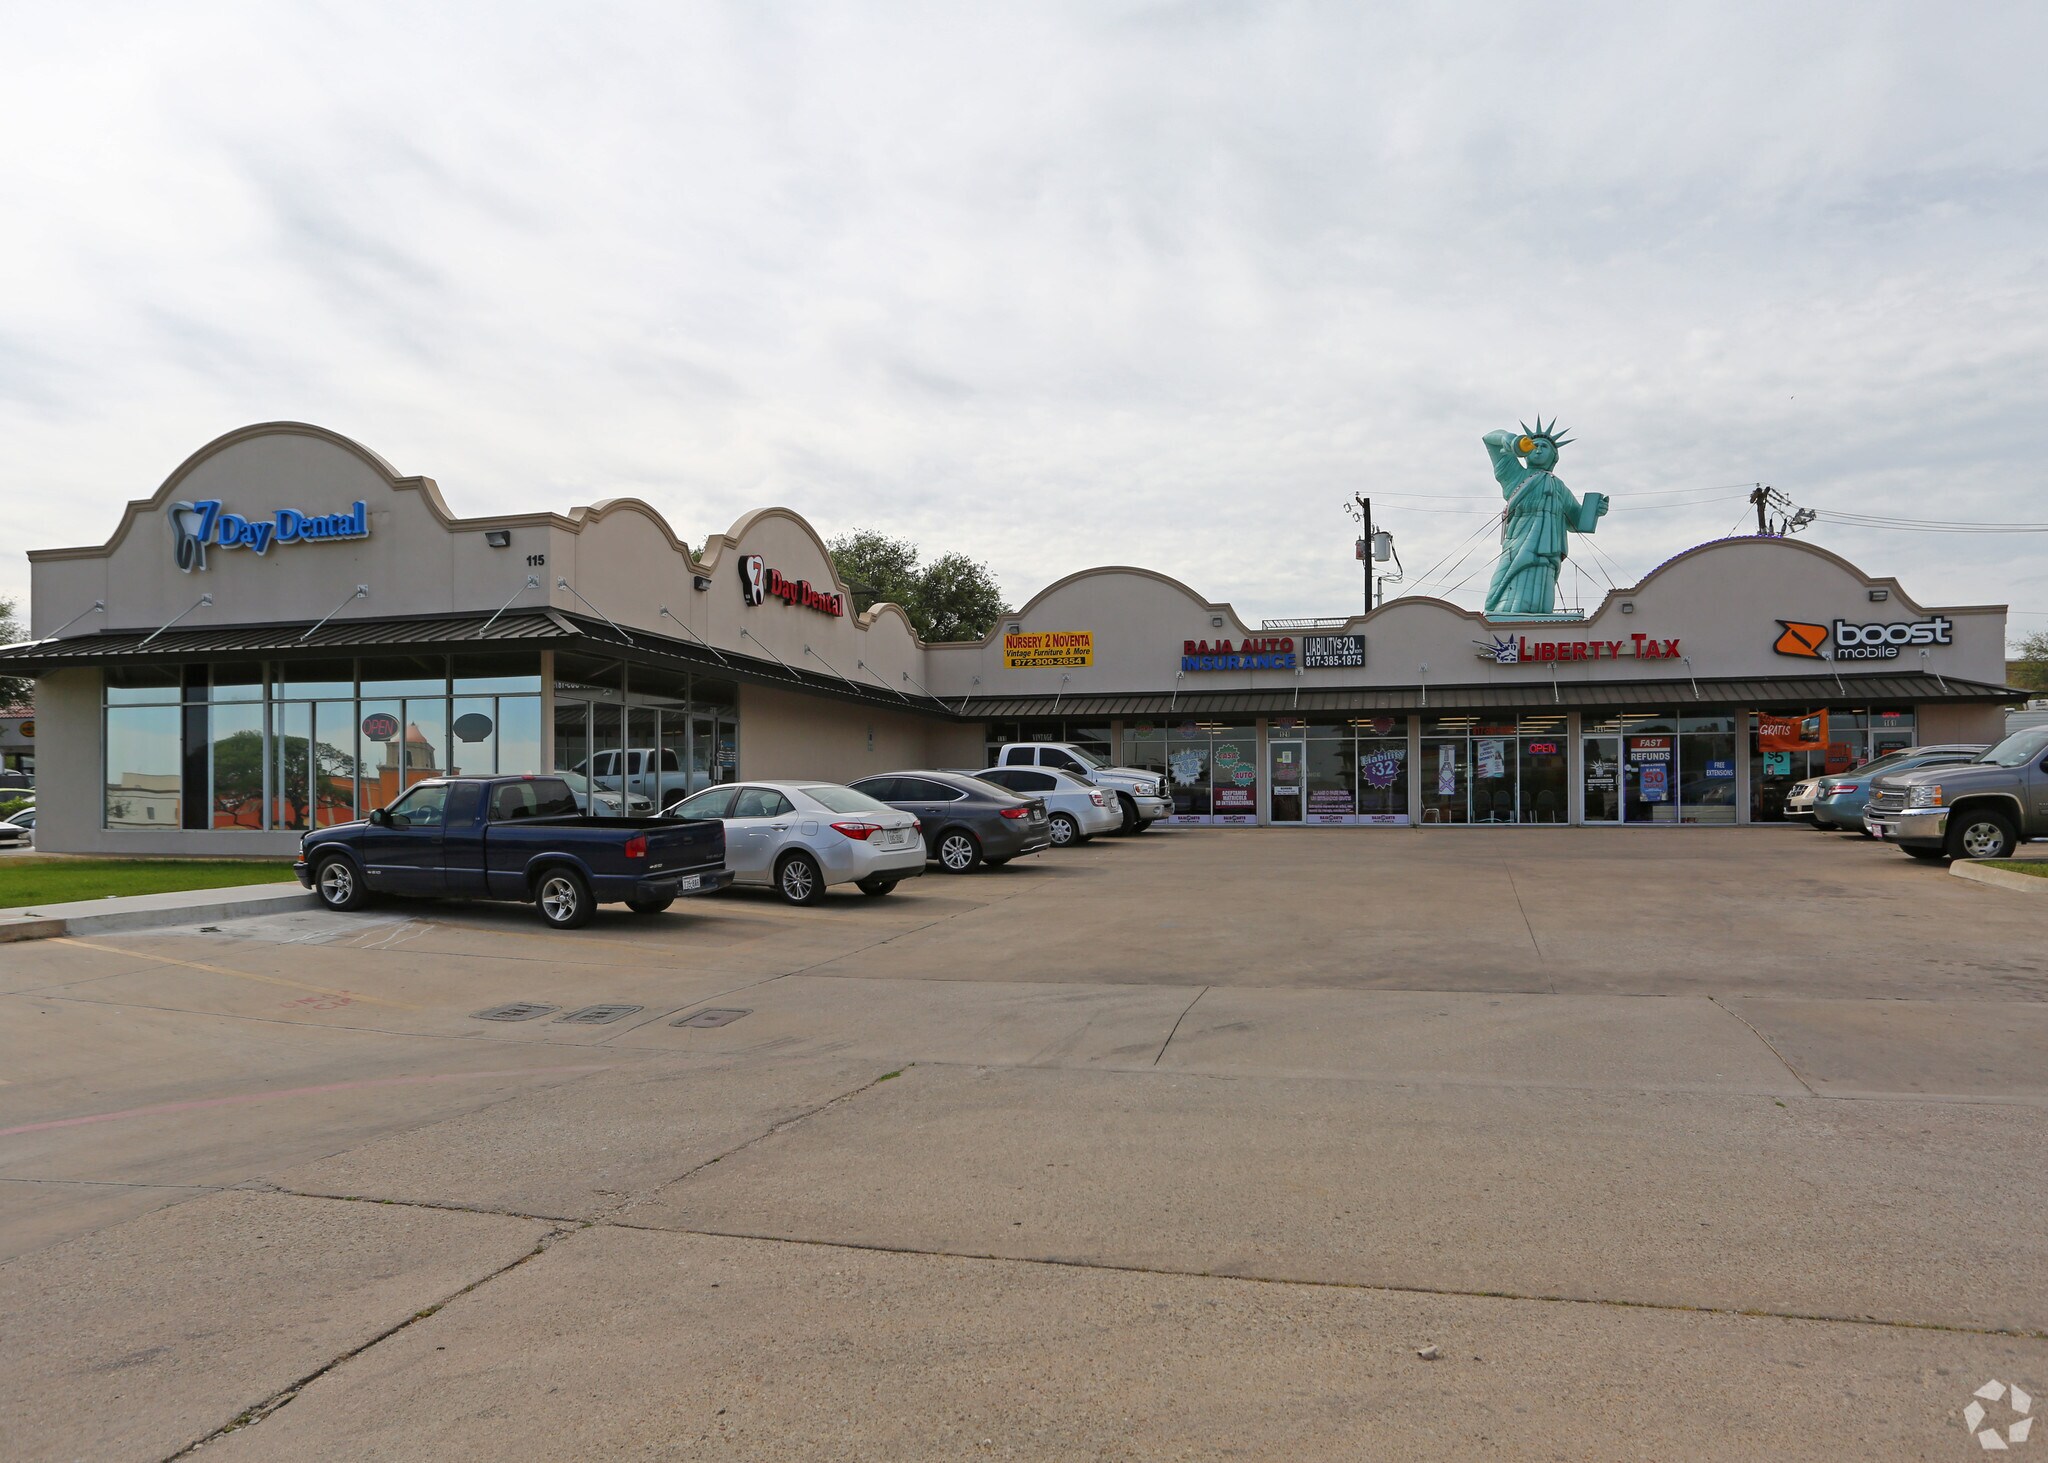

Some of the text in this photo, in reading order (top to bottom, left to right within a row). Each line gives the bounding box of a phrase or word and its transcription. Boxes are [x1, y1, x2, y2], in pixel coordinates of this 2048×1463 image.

[194, 500, 369, 555] 7 Day Dental
[526, 554, 545, 567] 115
[753, 561, 843, 617] 7 Day Dental
[1836, 617, 1951, 645] boost
[1006, 634, 1090, 648] NURSERY 2 NOVENTA
[1183, 637, 1295, 656] BAJA AUTO
[1305, 637, 1337, 656] LIABILITY
[1519, 633, 1681, 662] LIBERTY TAX
[1006, 650, 1031, 658] Vintage
[1034, 648, 1063, 656] Furniture
[1073, 647, 1090, 655] More
[1838, 648, 1897, 659] mobile
[1014, 658, 1082, 666] 972-900-2654
[1181, 654, 1297, 671] INSURANCE
[1305, 655, 1362, 667] 817-385-1875
[362, 719, 394, 735] OPEN
[1760, 724, 1790, 736] GRATIS
[1529, 743, 1556, 753] OPEN
[1640, 739, 1663, 747] FAST
[1631, 752, 1670, 761] REFUNDS
[1372, 761, 1394, 775] $32
